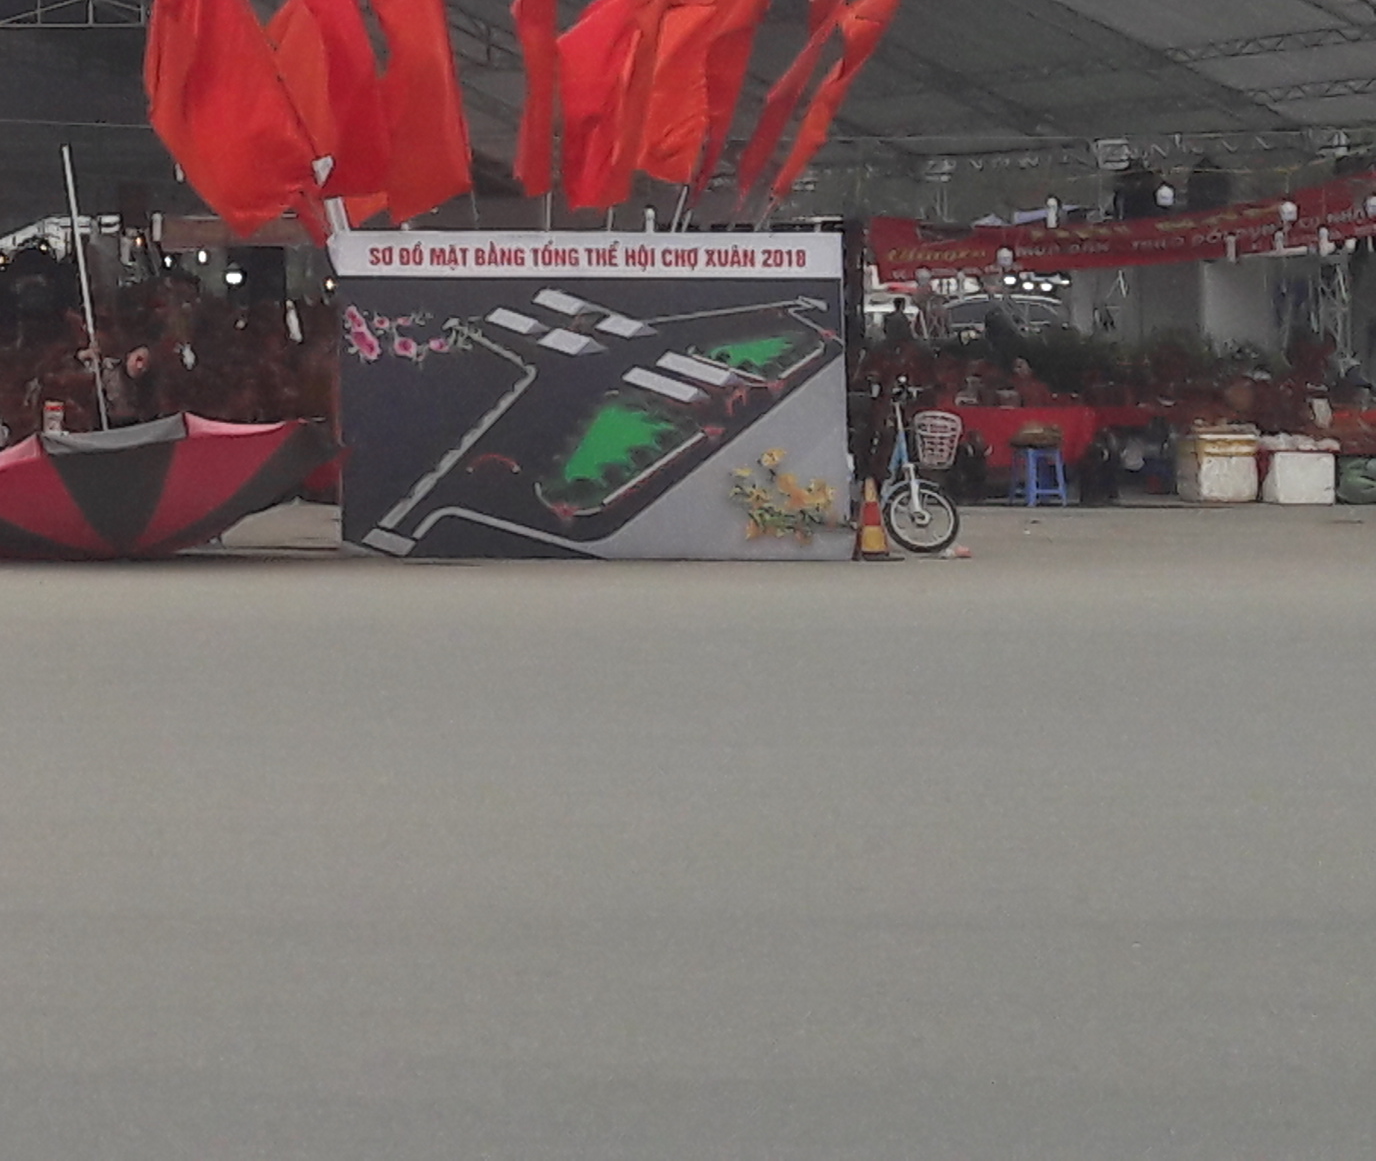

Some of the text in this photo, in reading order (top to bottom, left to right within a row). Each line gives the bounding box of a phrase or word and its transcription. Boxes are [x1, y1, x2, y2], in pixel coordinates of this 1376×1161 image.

[368, 246, 394, 267] SƠ
[624, 244, 655, 272] HỘI
[661, 247, 698, 272] CHỢ
[705, 244, 755, 268] XUÂN
[760, 248, 807, 268] 2018
